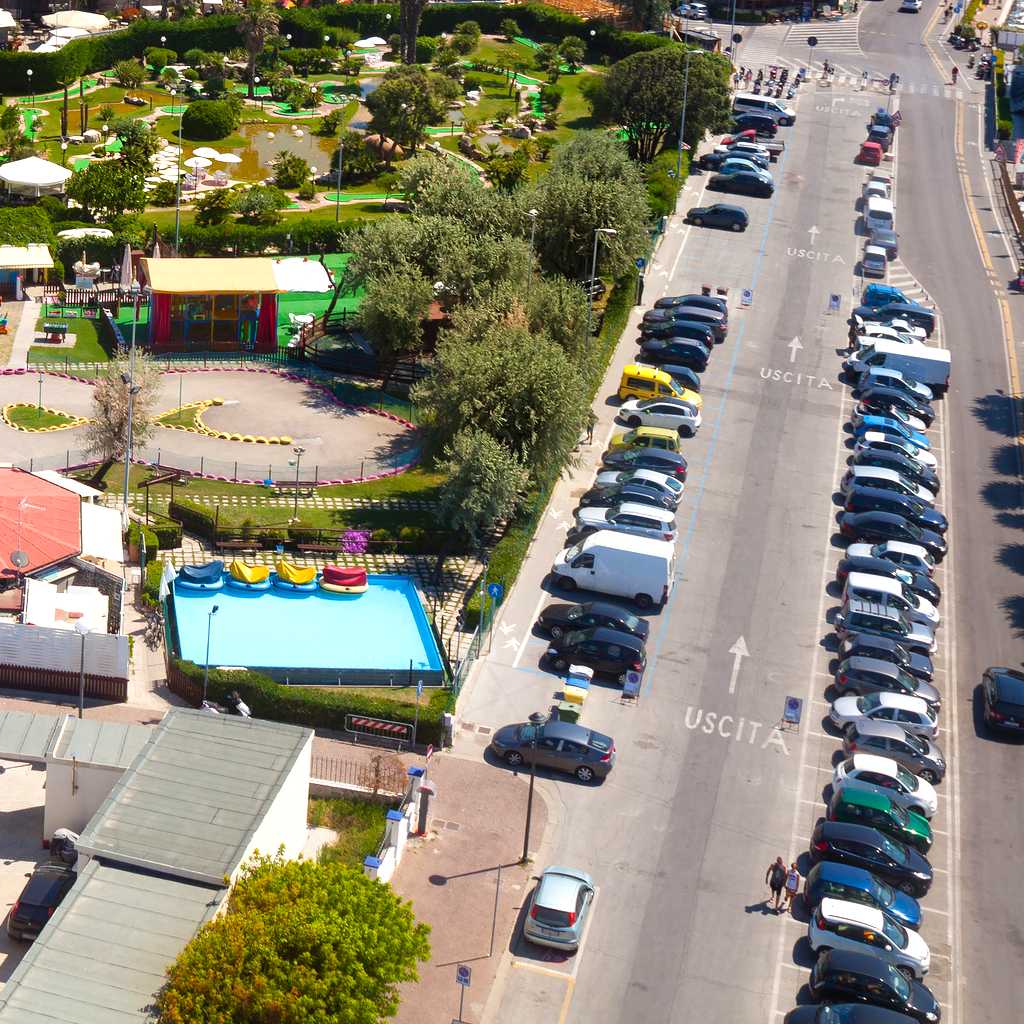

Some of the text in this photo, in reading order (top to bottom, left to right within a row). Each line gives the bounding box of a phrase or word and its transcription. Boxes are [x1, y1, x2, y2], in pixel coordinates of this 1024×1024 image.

[787, 247, 846, 265] USCITA
[760, 367, 833, 390] USCITA
[684, 706, 790, 756] USCITA
